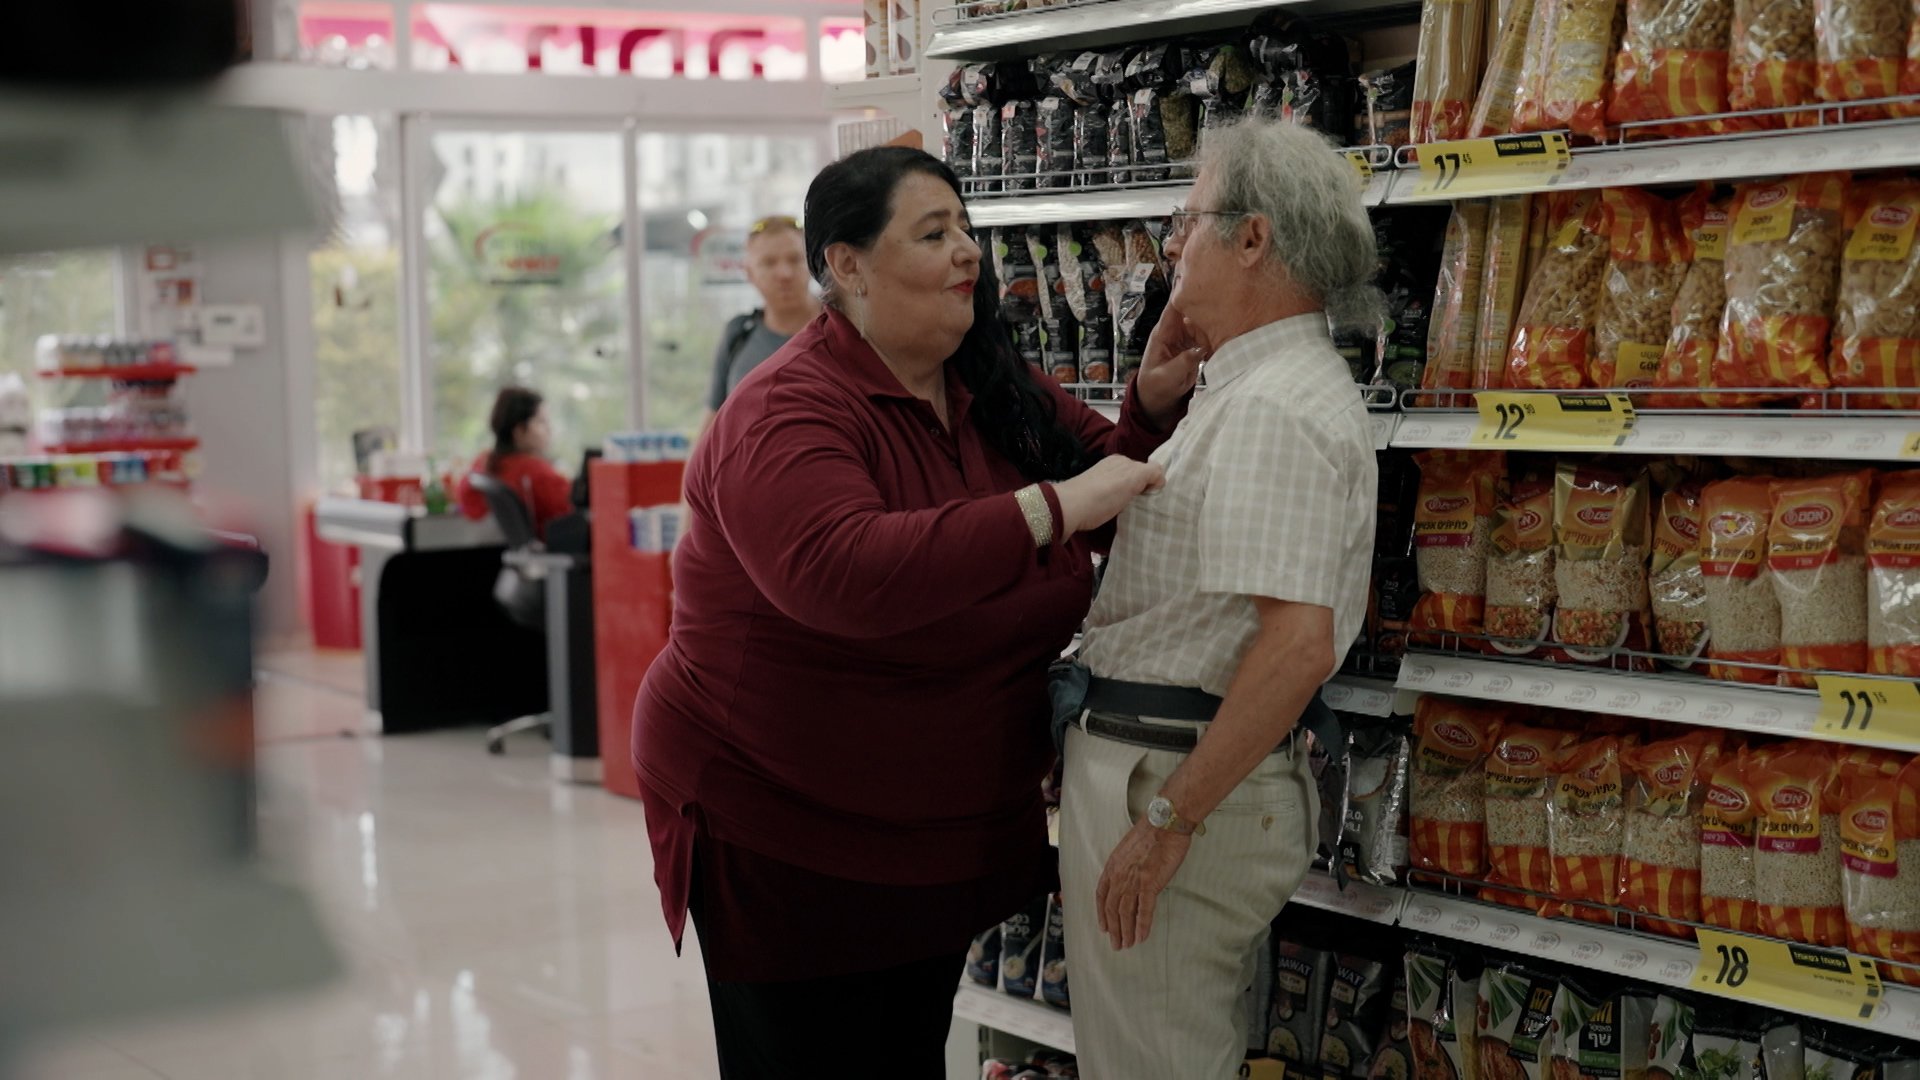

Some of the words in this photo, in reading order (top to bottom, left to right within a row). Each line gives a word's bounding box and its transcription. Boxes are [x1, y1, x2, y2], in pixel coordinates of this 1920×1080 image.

[1433, 153, 1461, 190] 17
[1462, 153, 1473, 164] 45
[1493, 402, 1525, 440] 12
[1840, 689, 1873, 730] 11
[1716, 944, 1749, 988] 18
[1587, 1033, 1613, 1049] שף
